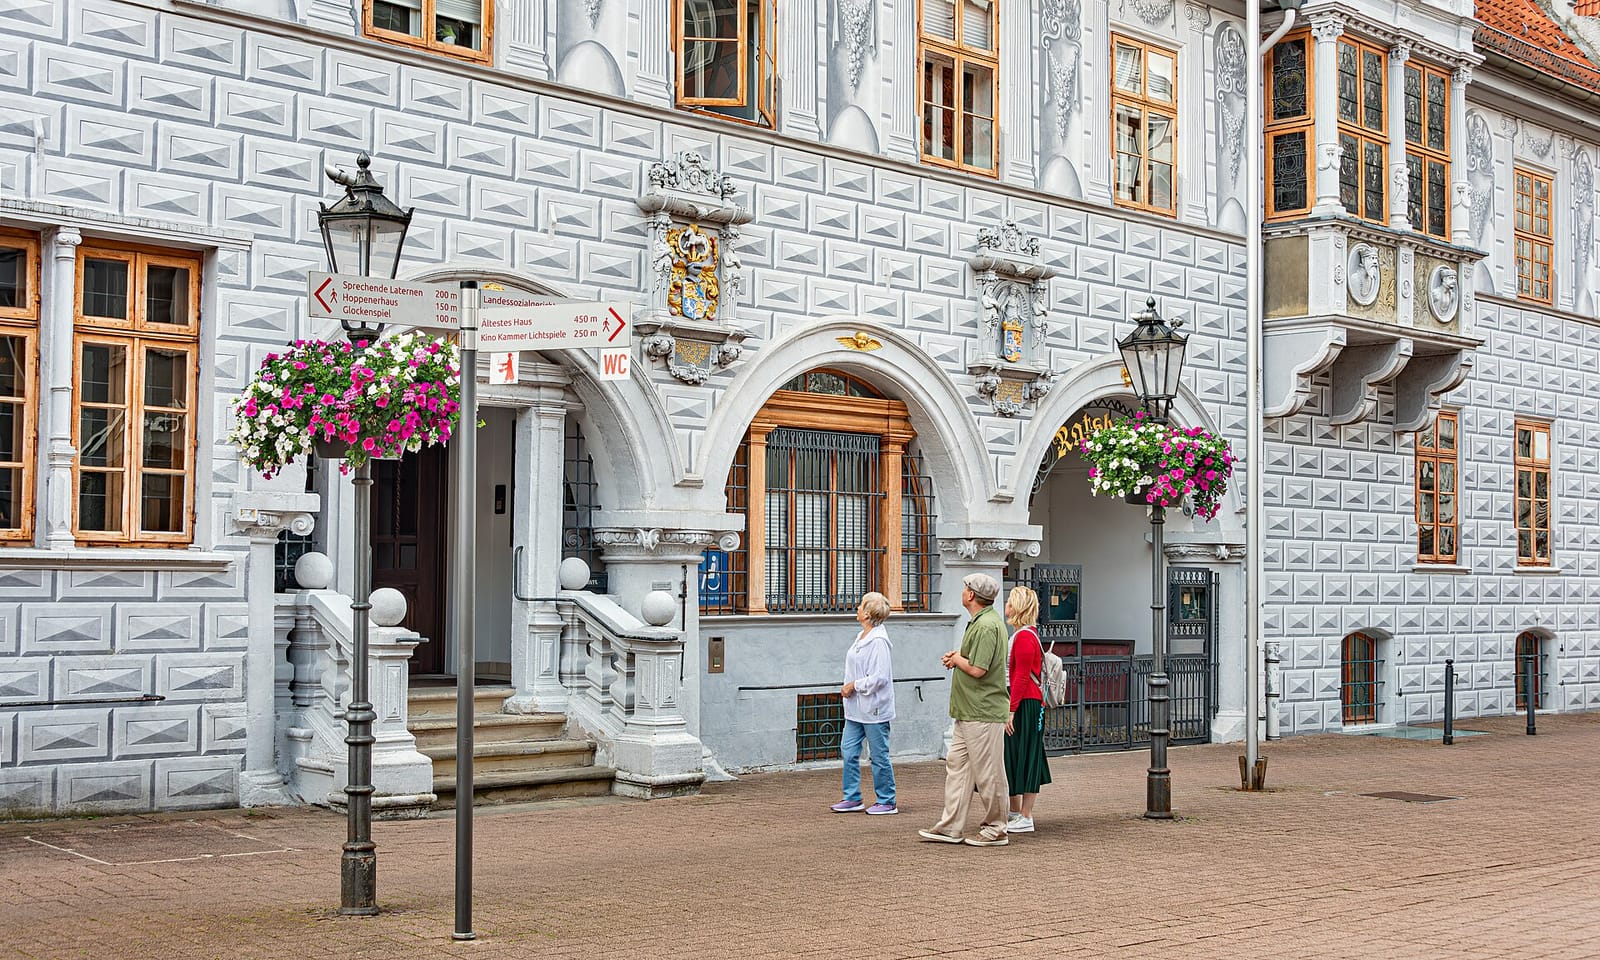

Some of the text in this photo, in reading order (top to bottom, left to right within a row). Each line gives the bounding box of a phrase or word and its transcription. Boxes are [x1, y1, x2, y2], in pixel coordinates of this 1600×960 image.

[342, 280, 458, 300] Sprechende Laternen 200 m
[342, 294, 458, 312] Hoppenerhaus 150 m
[342, 305, 458, 324] Glockenspiel 100 m
[481, 317, 512, 328] Ältestes
[513, 318, 533, 326] Haus
[573, 315, 589, 324] 450
[480, 333, 496, 342] Kino
[497, 332, 528, 341] Kammer
[528, 330, 567, 340] Lichtspiele
[573, 329, 589, 338] 250
[603, 353, 627, 375] WC
[1053, 412, 1113, 459] Ratsk
